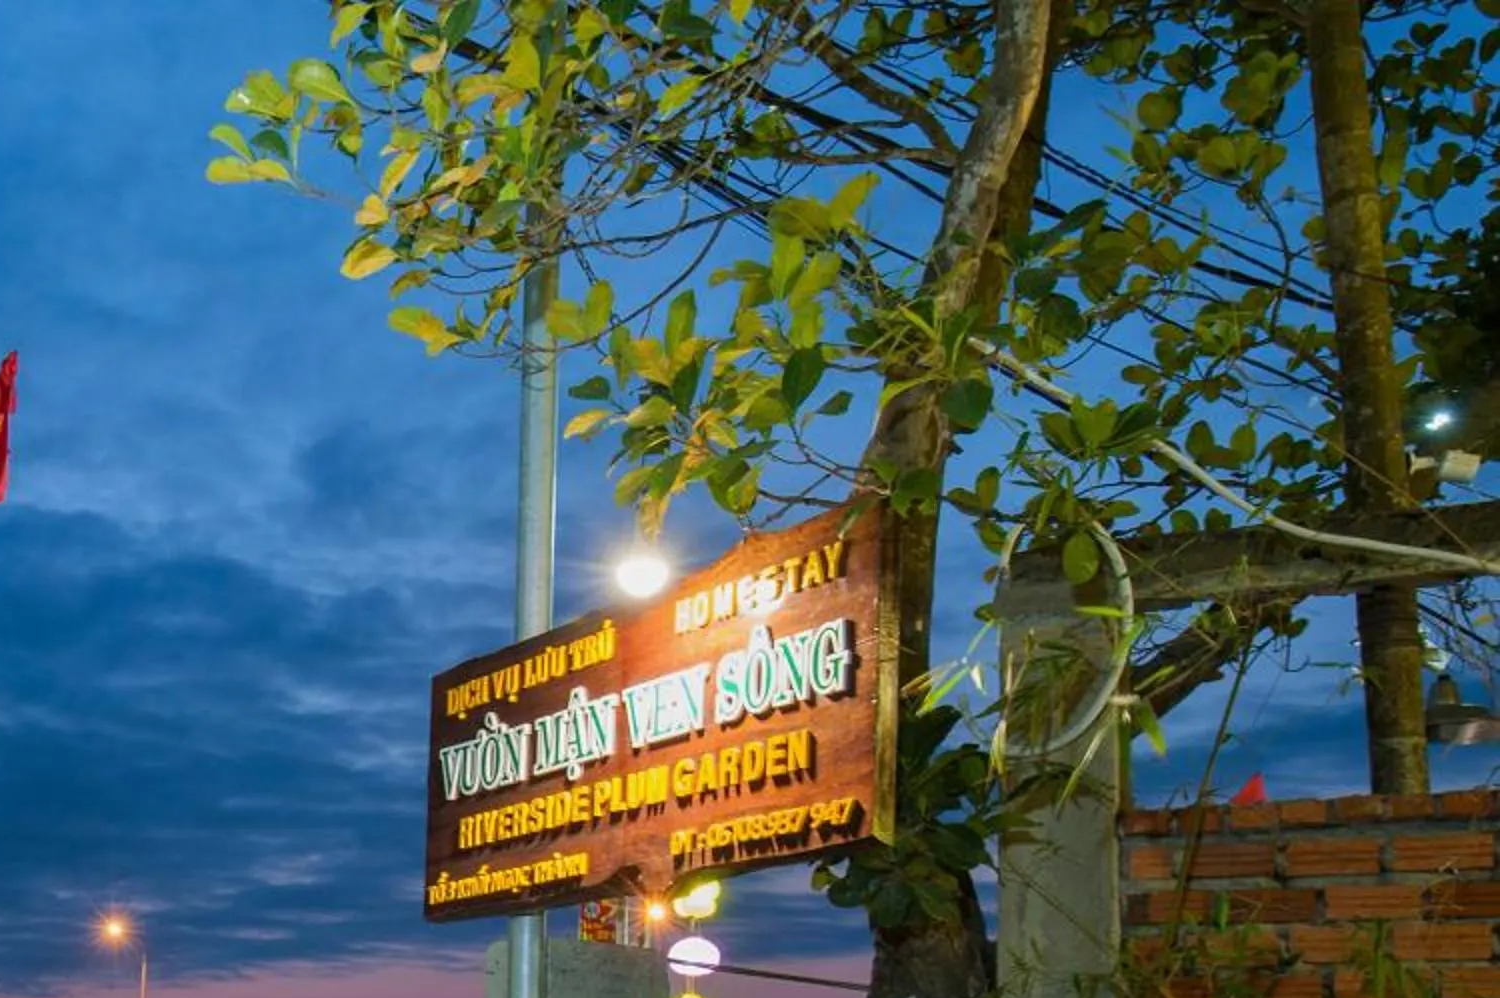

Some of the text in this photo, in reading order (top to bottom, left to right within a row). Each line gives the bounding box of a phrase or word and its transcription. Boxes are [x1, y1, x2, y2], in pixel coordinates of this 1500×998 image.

[674, 541, 844, 634] HOMESTAY
[439, 623, 852, 800] VƯỜN MẬN VEN SÔNG
[492, 663, 522, 703] VỤ
[459, 729, 813, 848] RIVERSIDE PLUM GARDEN
